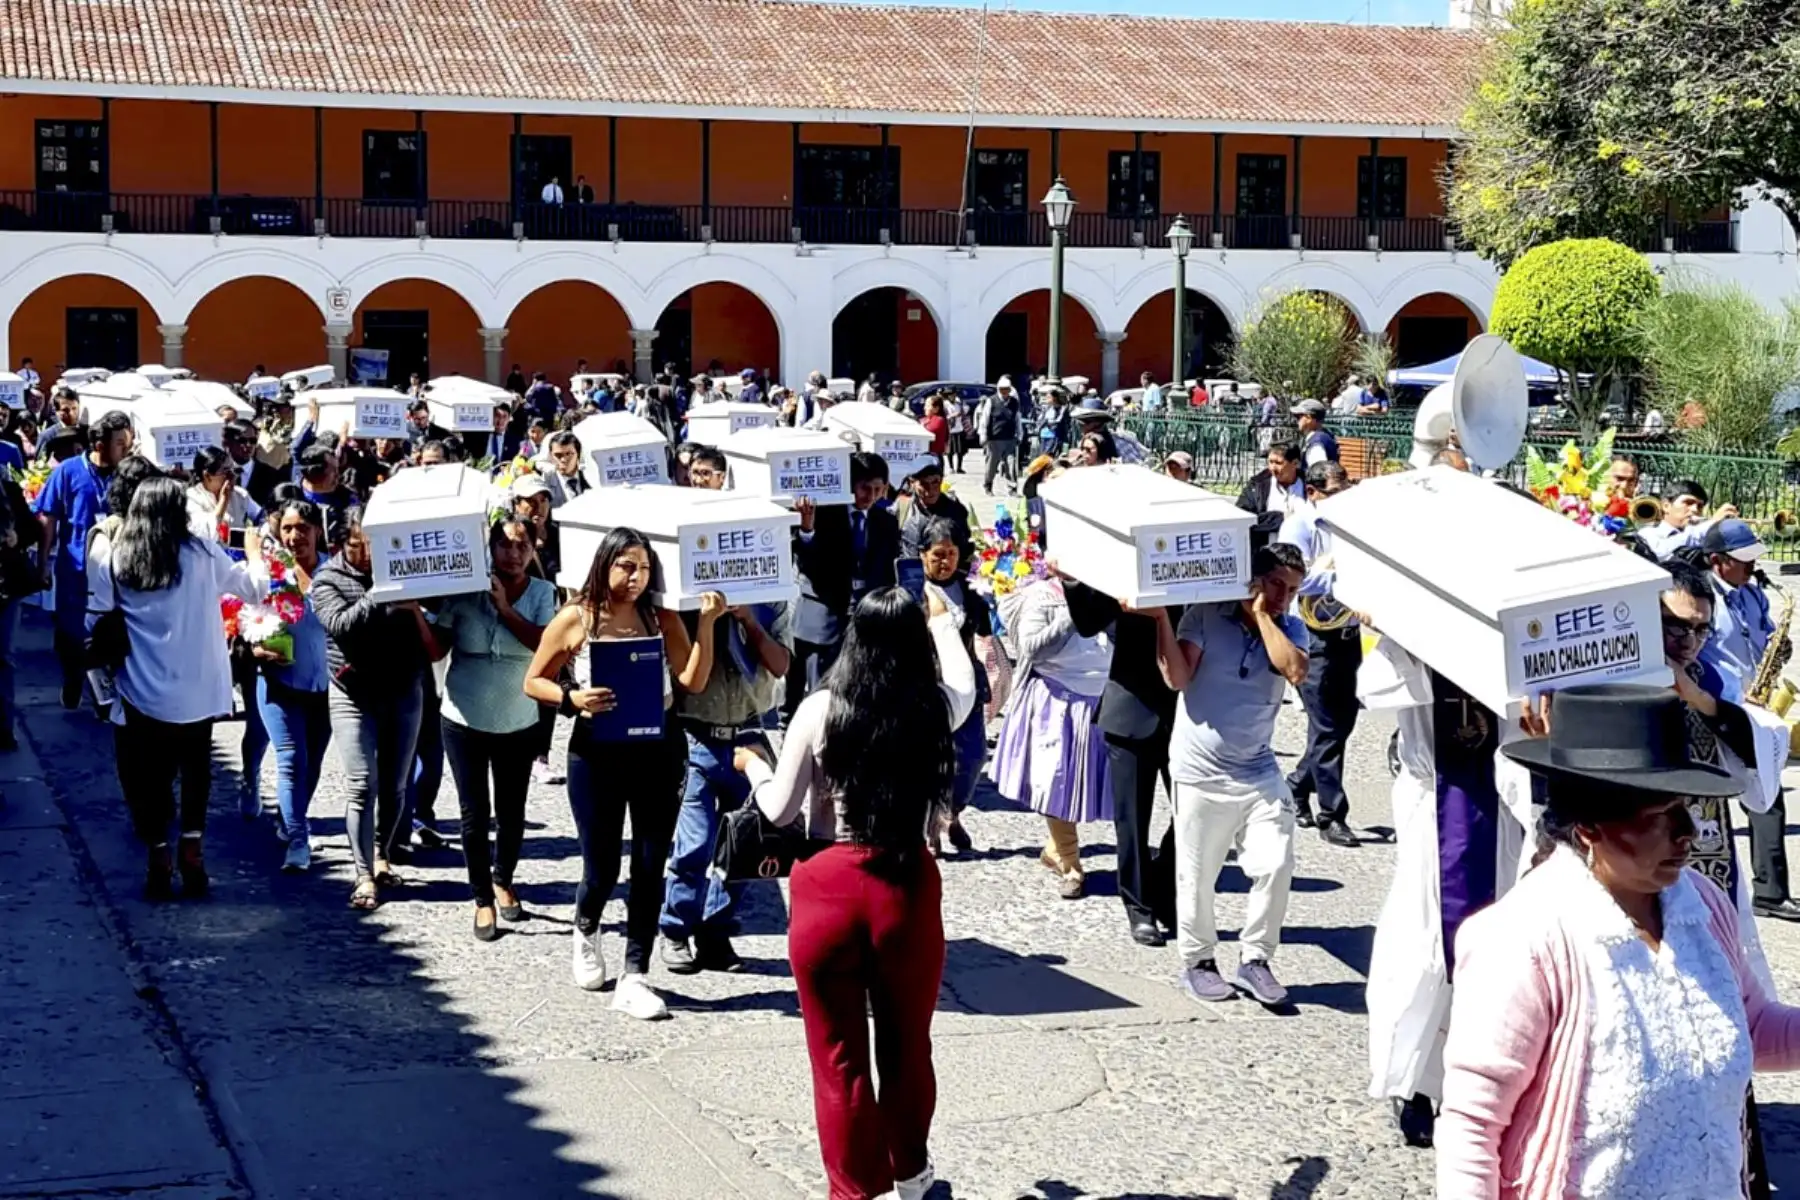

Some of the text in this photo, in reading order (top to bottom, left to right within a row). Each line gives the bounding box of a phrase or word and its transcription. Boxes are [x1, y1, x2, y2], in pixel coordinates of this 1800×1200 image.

[178, 431, 200, 443] EFE
[620, 451, 642, 463] EFE
[798, 456, 824, 469] EFE
[411, 530, 447, 550] EFE
[718, 530, 754, 550] EFE
[1175, 532, 1212, 552] EFE
[388, 552, 471, 577] APOLINARIO TAIPE LAGOS
[693, 555, 776, 581] ADELINA CORDERO DE TAIPE
[1151, 560, 1180, 582] FELICIANO
[1181, 558, 1210, 579] CARDENAS
[1555, 603, 1606, 635] EFE
[1523, 649, 1556, 679] MARIO
[1558, 641, 1599, 672] CHALCO
[1601, 632, 1636, 663] CUCHO
